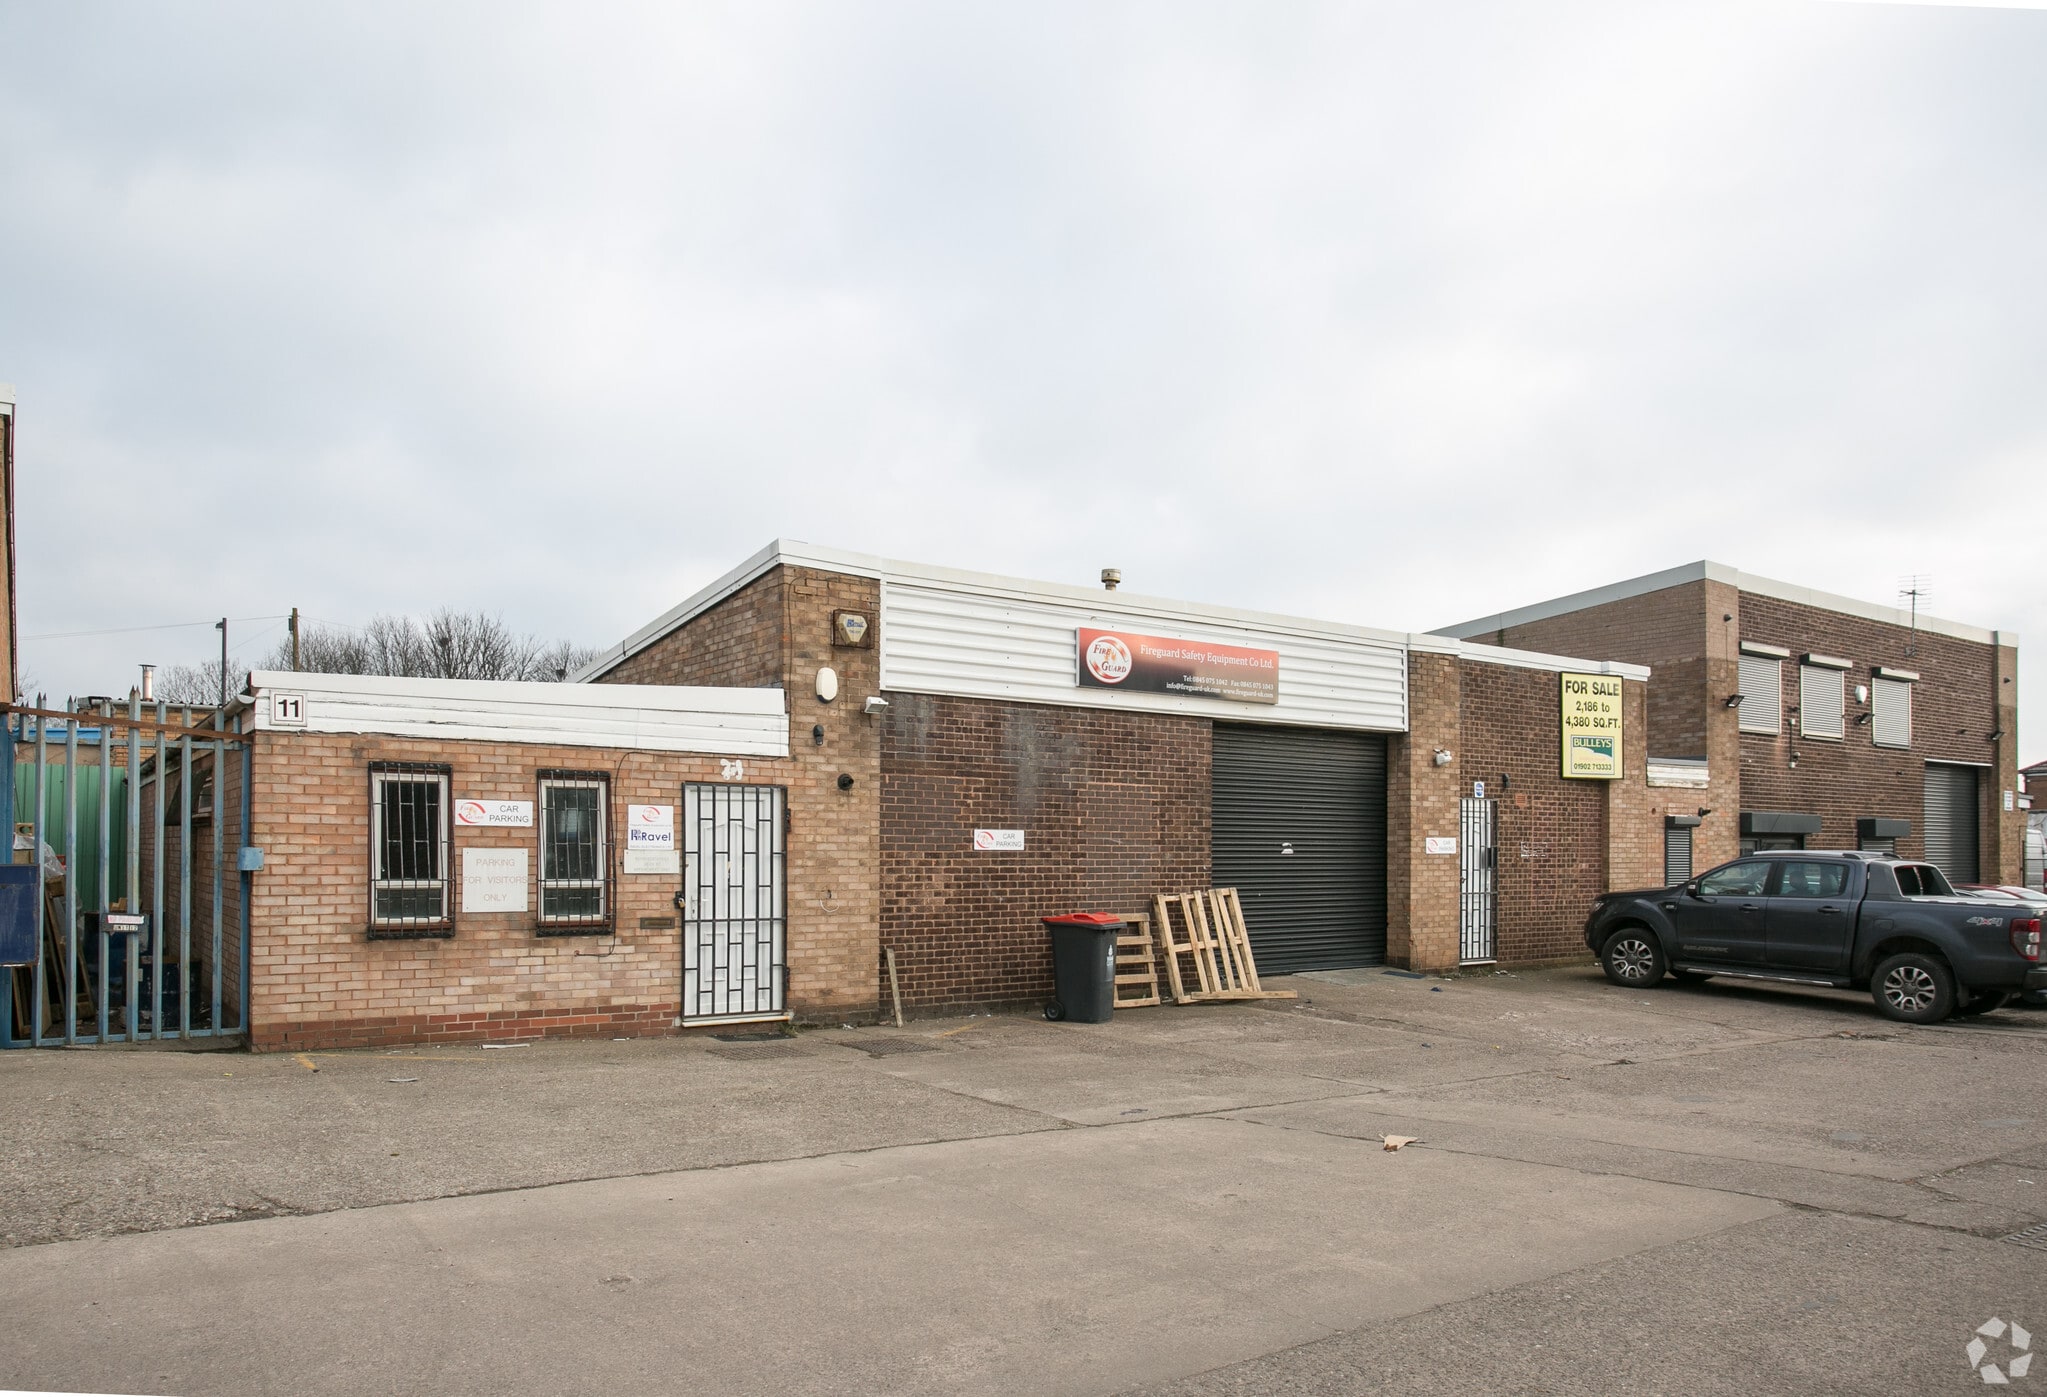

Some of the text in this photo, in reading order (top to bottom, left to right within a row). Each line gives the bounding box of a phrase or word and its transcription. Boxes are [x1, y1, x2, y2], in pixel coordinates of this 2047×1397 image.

[1093, 644, 1111, 655] FIRE
[1140, 645, 1274, 669] Fireguard Safety Equipment Co Ltd.
[1101, 660, 1127, 673] GUARD
[1565, 680, 1620, 696] FOR SALE
[278, 699, 300, 718] 11
[1576, 701, 1610, 713] 2,186 to
[1565, 716, 1621, 729] 4,380 SQ.FT.
[1574, 738, 1612, 748] BULLEYS
[499, 805, 519, 813] CAR
[489, 814, 529, 823] PARKING
[642, 832, 671, 841] Ravel
[476, 858, 515, 867] PARKING
[464, 876, 528, 884] FOR VISITORS
[483, 893, 508, 902] ONLY
[1966, 916, 2003, 926] 4x4
